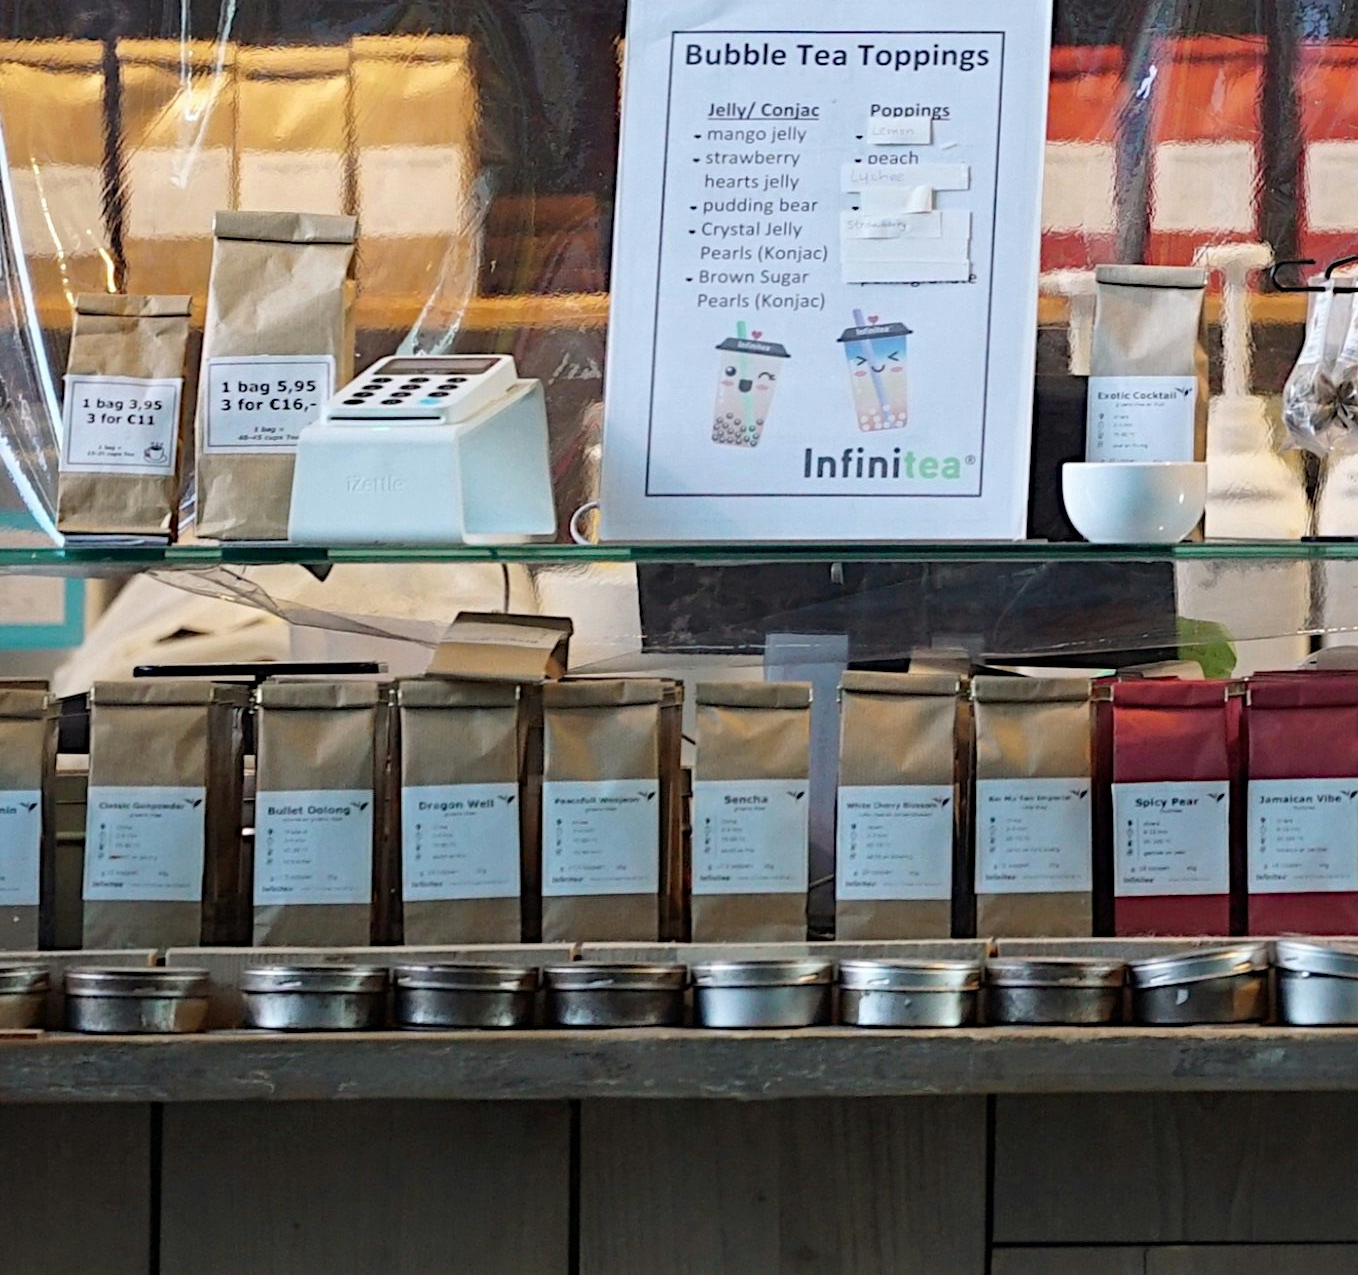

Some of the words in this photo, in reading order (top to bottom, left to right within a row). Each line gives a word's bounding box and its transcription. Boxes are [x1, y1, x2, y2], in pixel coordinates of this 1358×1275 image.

[685, 43, 786, 66] Bubble
[797, 44, 847, 66] Tea
[858, 44, 989, 71] Toppings
[708, 102, 755, 119] Jelly/
[761, 103, 820, 119] Conjac
[870, 103, 950, 120] Poppings
[708, 129, 766, 142] mango
[770, 127, 807, 143] jelly
[706, 150, 800, 166] strawberry
[868, 151, 919, 165] peach
[704, 174, 758, 189] hearts
[763, 174, 799, 191] jelly
[703, 197, 774, 215] pudding
[779, 198, 818, 212] bear
[701, 222, 760, 239] Crystal
[764, 222, 802, 239] Jelly
[700, 245, 752, 260] Pearls
[757, 245, 829, 263] (Konjac)
[699, 270, 755, 284] Brown
[760, 270, 809, 287] Sugar
[697, 293, 750, 309] Pearls
[754, 293, 826, 311] (Konjac)
[222, 382, 229, 393] 1
[238, 381, 270, 396] bag
[277, 381, 316, 395] 5,95
[1098, 391, 1131, 400] Exotic
[1133, 391, 1177, 400] Cocktail
[83, 398, 90, 408] 1
[97, 398, 123, 411] bag
[129, 399, 162, 411] 3,95
[221, 399, 232, 411] 3
[238, 398, 263, 411] for
[87, 414, 96, 424] 3
[101, 413, 122, 424] for
[803, 447, 961, 480] Infinitea
[418, 801, 465, 812] Dragon
[467, 799, 495, 809] Well
[724, 794, 769, 805] Sencha
[847, 801, 872, 810] White
[1135, 797, 1168, 810] Spicy
[1171, 797, 1199, 807] Pear
[1259, 794, 1313, 805] Jamaican
[1316, 794, 1342, 803] Vibe
[268, 806, 304, 816] Bullet
[307, 806, 351, 817] Oolong
